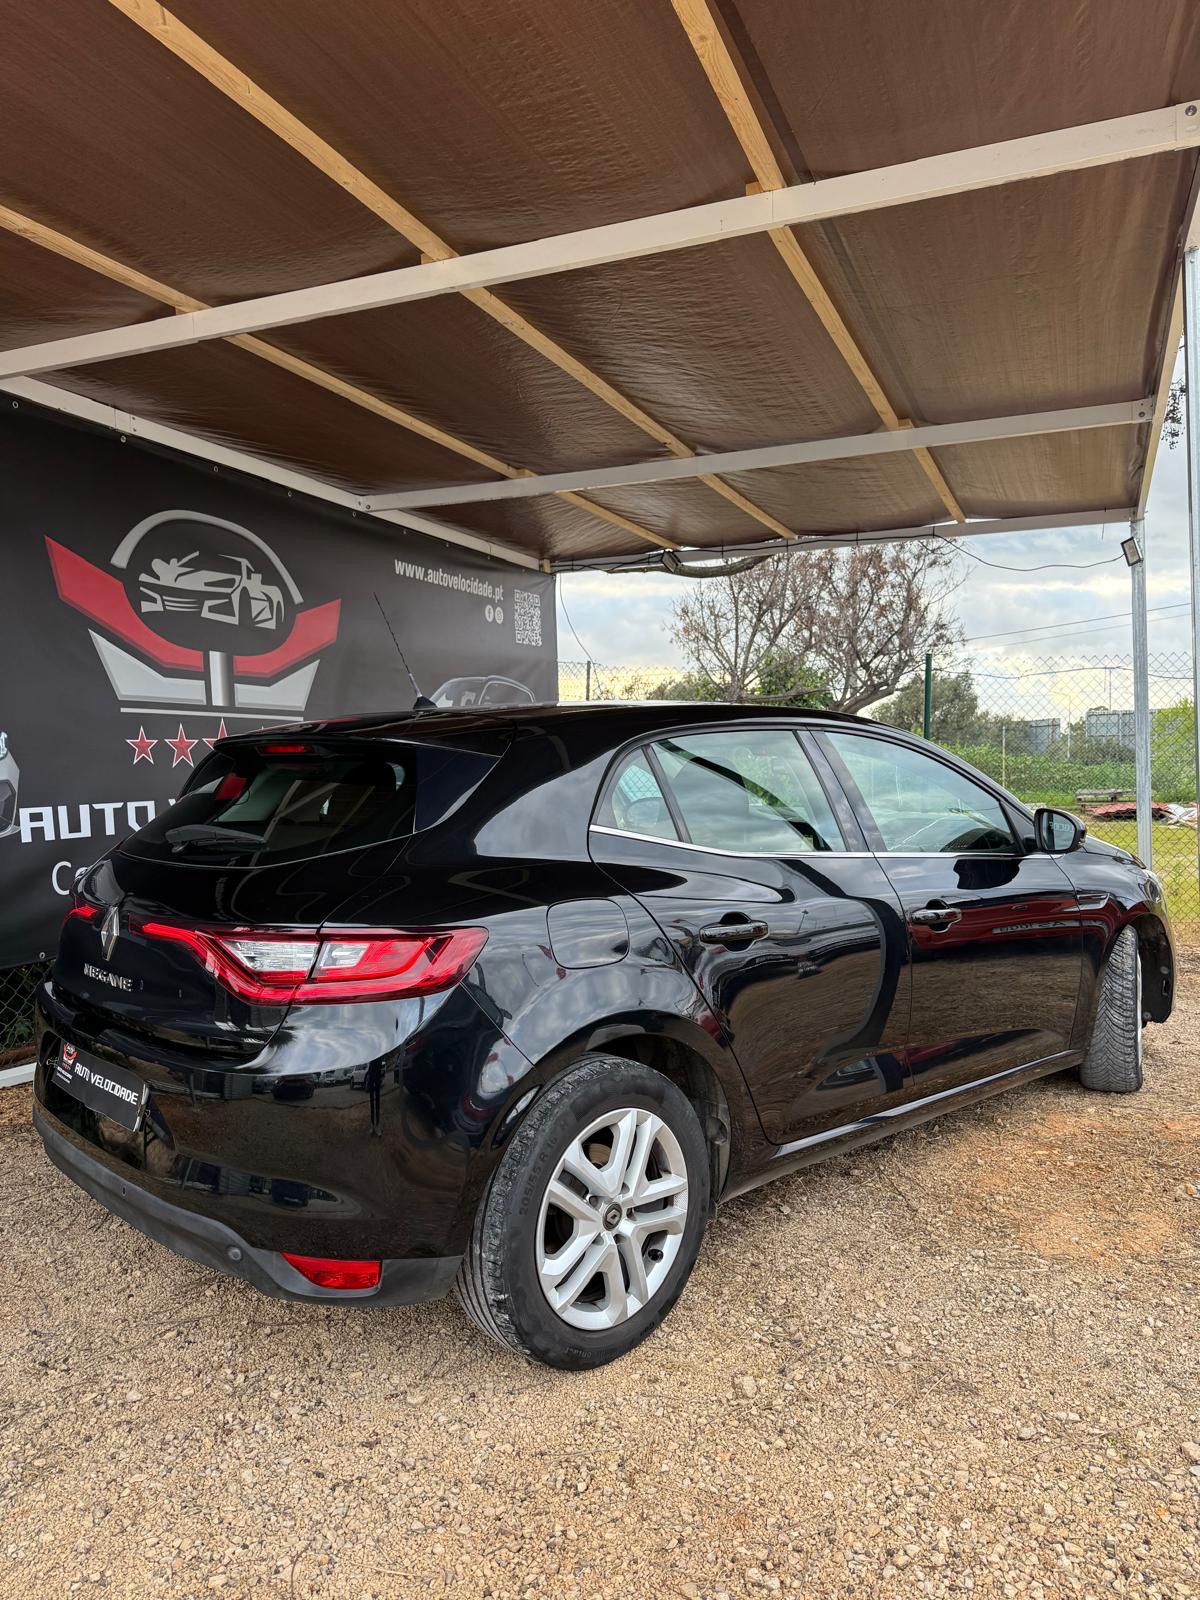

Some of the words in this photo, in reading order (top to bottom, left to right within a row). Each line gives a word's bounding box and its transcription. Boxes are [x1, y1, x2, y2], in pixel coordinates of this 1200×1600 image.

[394, 559, 504, 603] www.autovelocidade.pt
[19, 800, 156, 843] AUTO
[83, 963, 133, 992] MEGANE
[90, 1071, 139, 1106] VELOCIDADE
